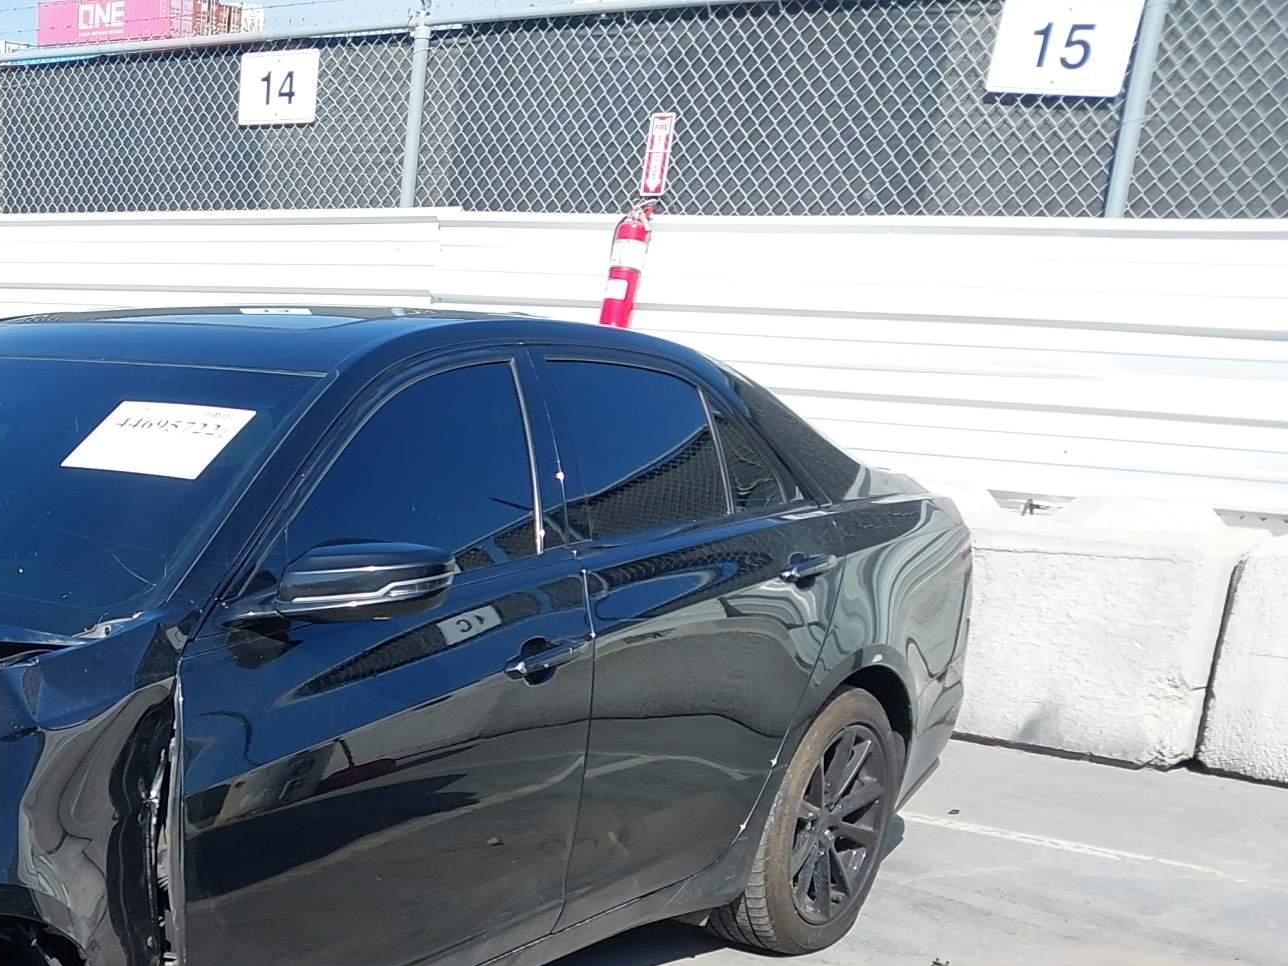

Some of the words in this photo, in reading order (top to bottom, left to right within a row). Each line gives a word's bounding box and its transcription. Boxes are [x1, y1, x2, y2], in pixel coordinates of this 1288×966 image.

[78, 2, 125, 29] ONE
[1034, 22, 1096, 69] 15
[261, 71, 296, 105] 14
